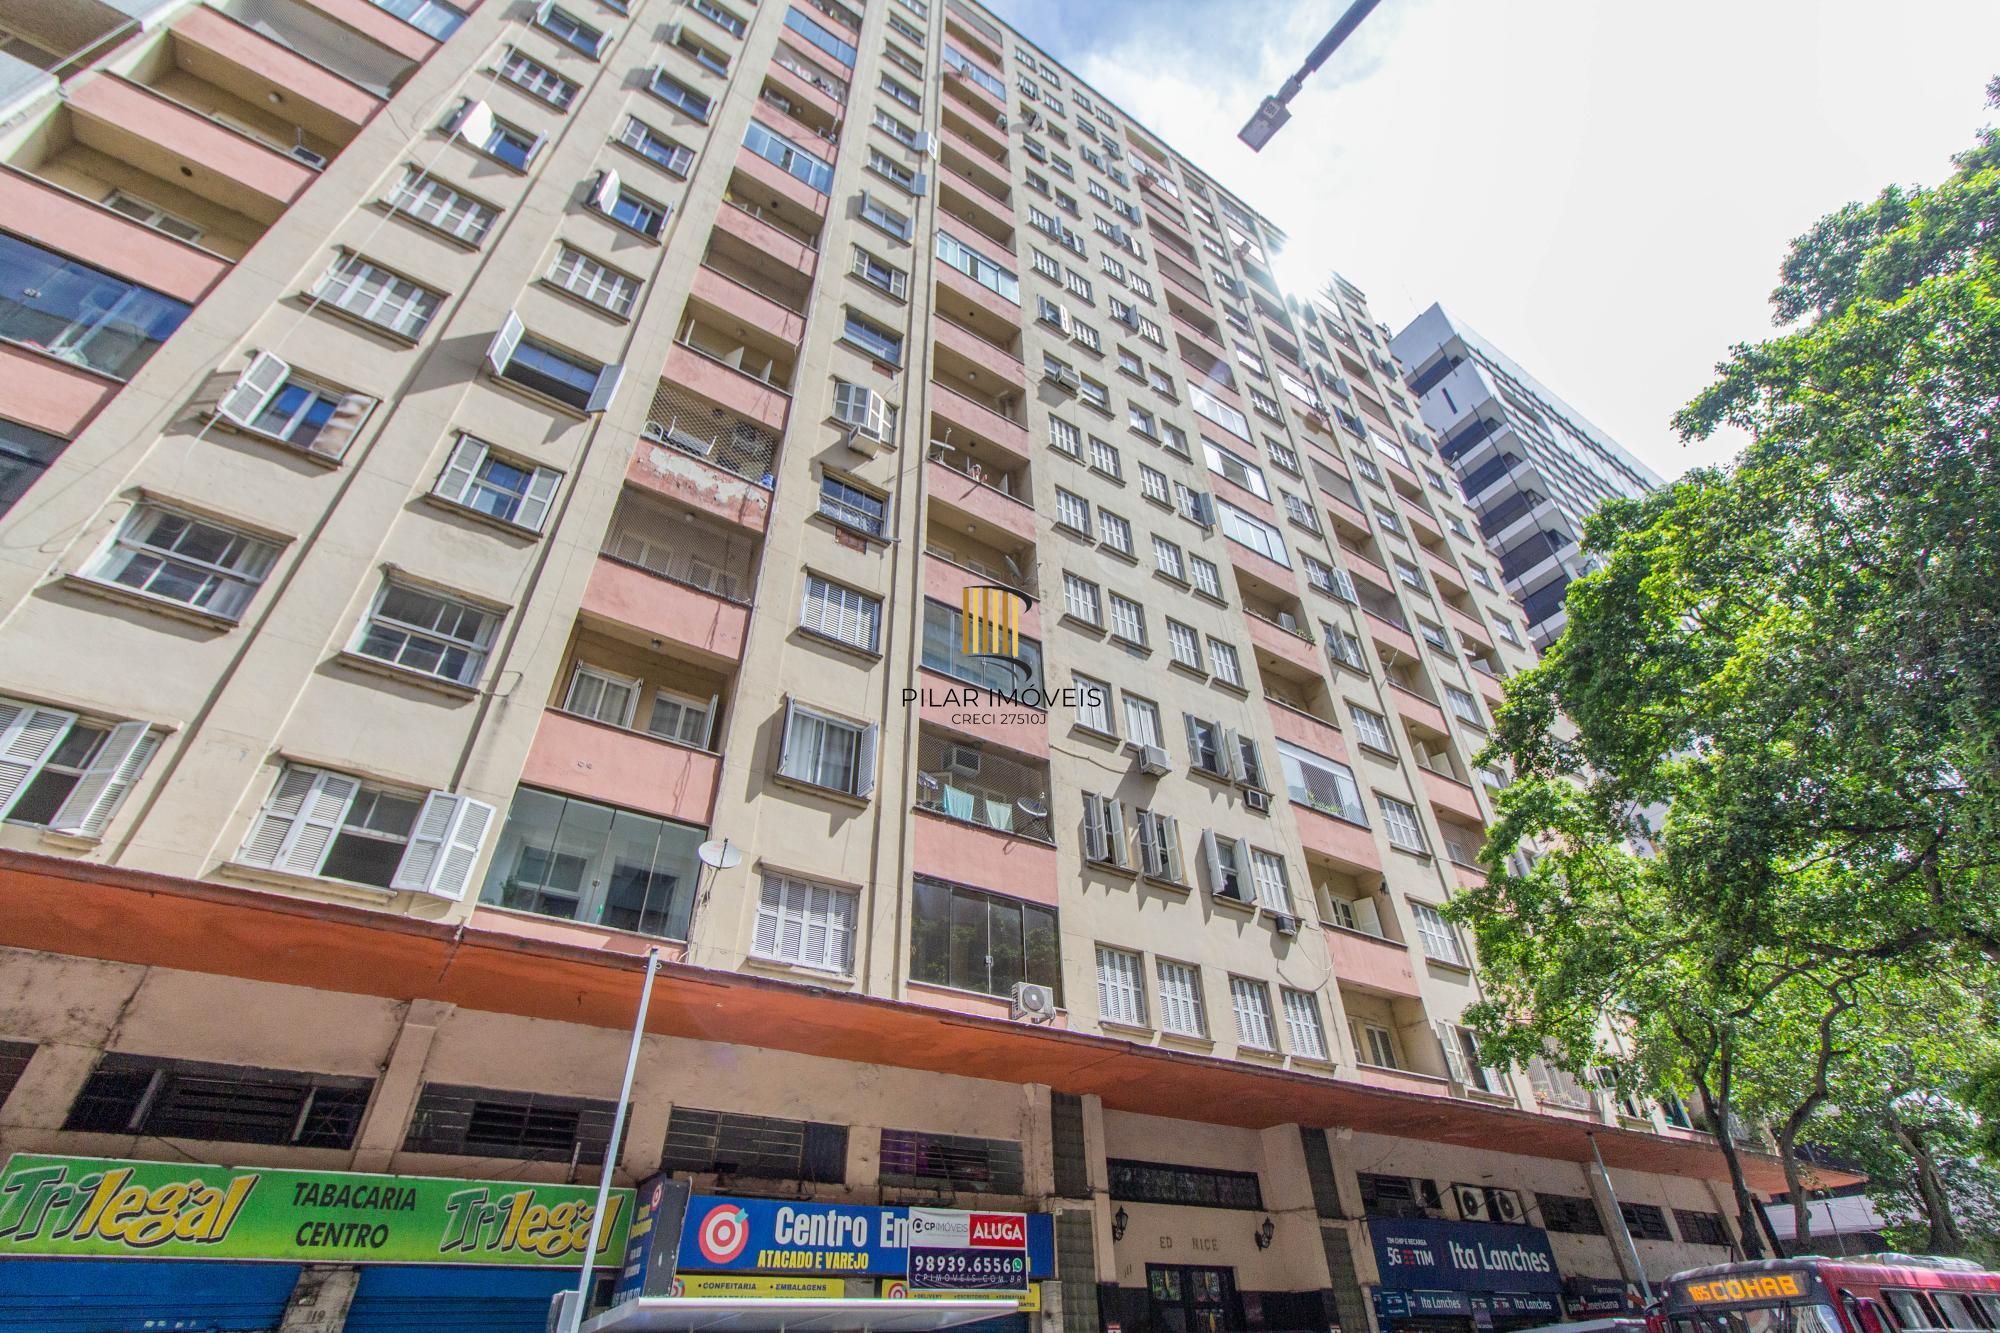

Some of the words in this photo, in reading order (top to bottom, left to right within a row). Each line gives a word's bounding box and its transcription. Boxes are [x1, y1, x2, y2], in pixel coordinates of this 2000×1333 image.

[293, 1182, 417, 1211] TABACARIA
[0, 1166, 260, 1248] Trilegal
[295, 1221, 389, 1249] CENTRO
[774, 1206, 868, 1247] Centro
[972, 1221, 1023, 1241] ALUGA
[1160, 1236, 1173, 1249] ED
[757, 1249, 813, 1269] ATACADO
[815, 1250, 823, 1269] E
[825, 1251, 869, 1269] VAREJO
[915, 1255, 1011, 1273] 98939.6556
[1387, 1247, 1402, 1266] 5G
[1413, 1249, 1435, 1266] TIM
[1448, 1240, 1478, 1269] Ita
[1478, 1242, 1550, 1273] Lanches
[702, 1282, 757, 1290] CONFEITARIA
[775, 1283, 827, 1291] EMBALAGENS
[1709, 1275, 1800, 1301] COHAB
[1431, 1296, 1461, 1309] Lanches
[1524, 1298, 1552, 1310] Lanches
